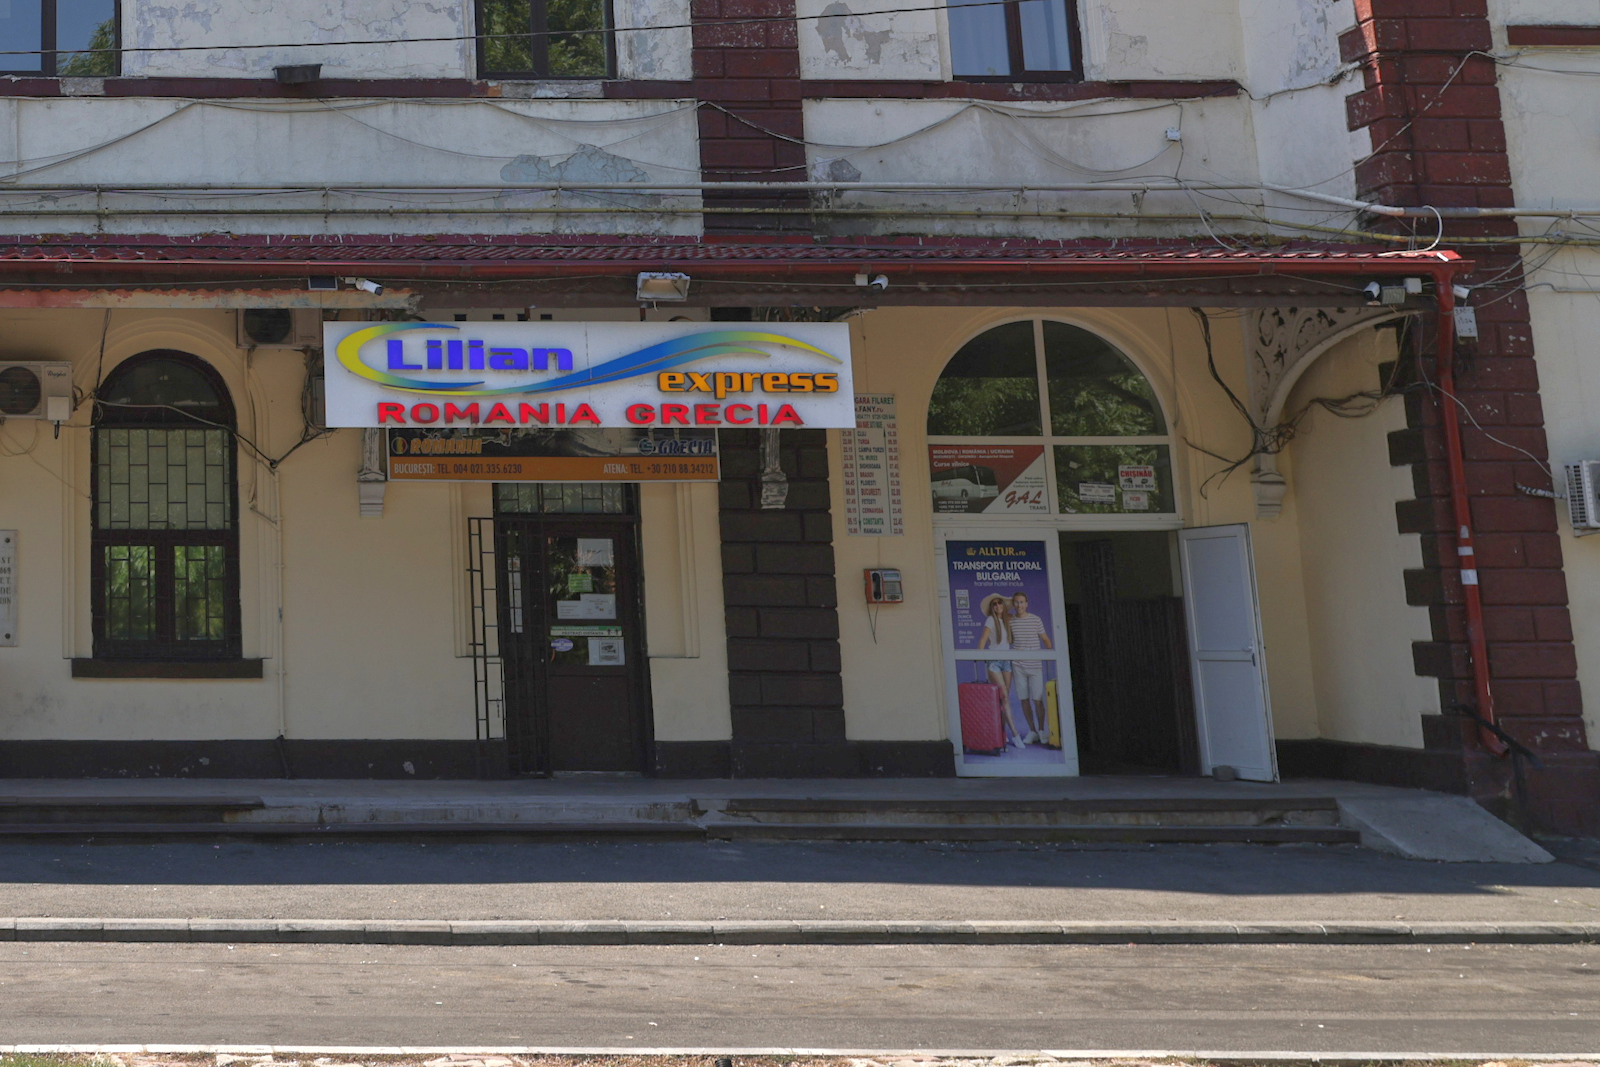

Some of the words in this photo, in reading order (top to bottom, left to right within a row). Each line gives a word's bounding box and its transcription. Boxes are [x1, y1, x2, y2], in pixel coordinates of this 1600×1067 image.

[387, 339, 573, 371] Lilian
[658, 372, 838, 399] express
[872, 397, 894, 405] FILARET
[377, 402, 601, 425] ROMANIA
[625, 403, 804, 425] GRECIA
[410, 437, 483, 454] ROMANIA
[658, 439, 714, 455] GRECIA
[438, 463, 450, 474] TEL.
[454, 463, 468, 474] 004
[603, 463, 628, 474] ATENA:
[630, 463, 644, 474] TEL.
[646, 463, 660, 473] +30
[664, 463, 676, 473] 210
[1004, 490, 1042, 509] GAL
[952, 561, 1004, 570] TRANSPORT
[1006, 561, 1042, 570] LITORAL
[976, 572, 1021, 581] BULGARIA
[0, 587, 12, 595] DE
[0, 597, 12, 605] DIN
